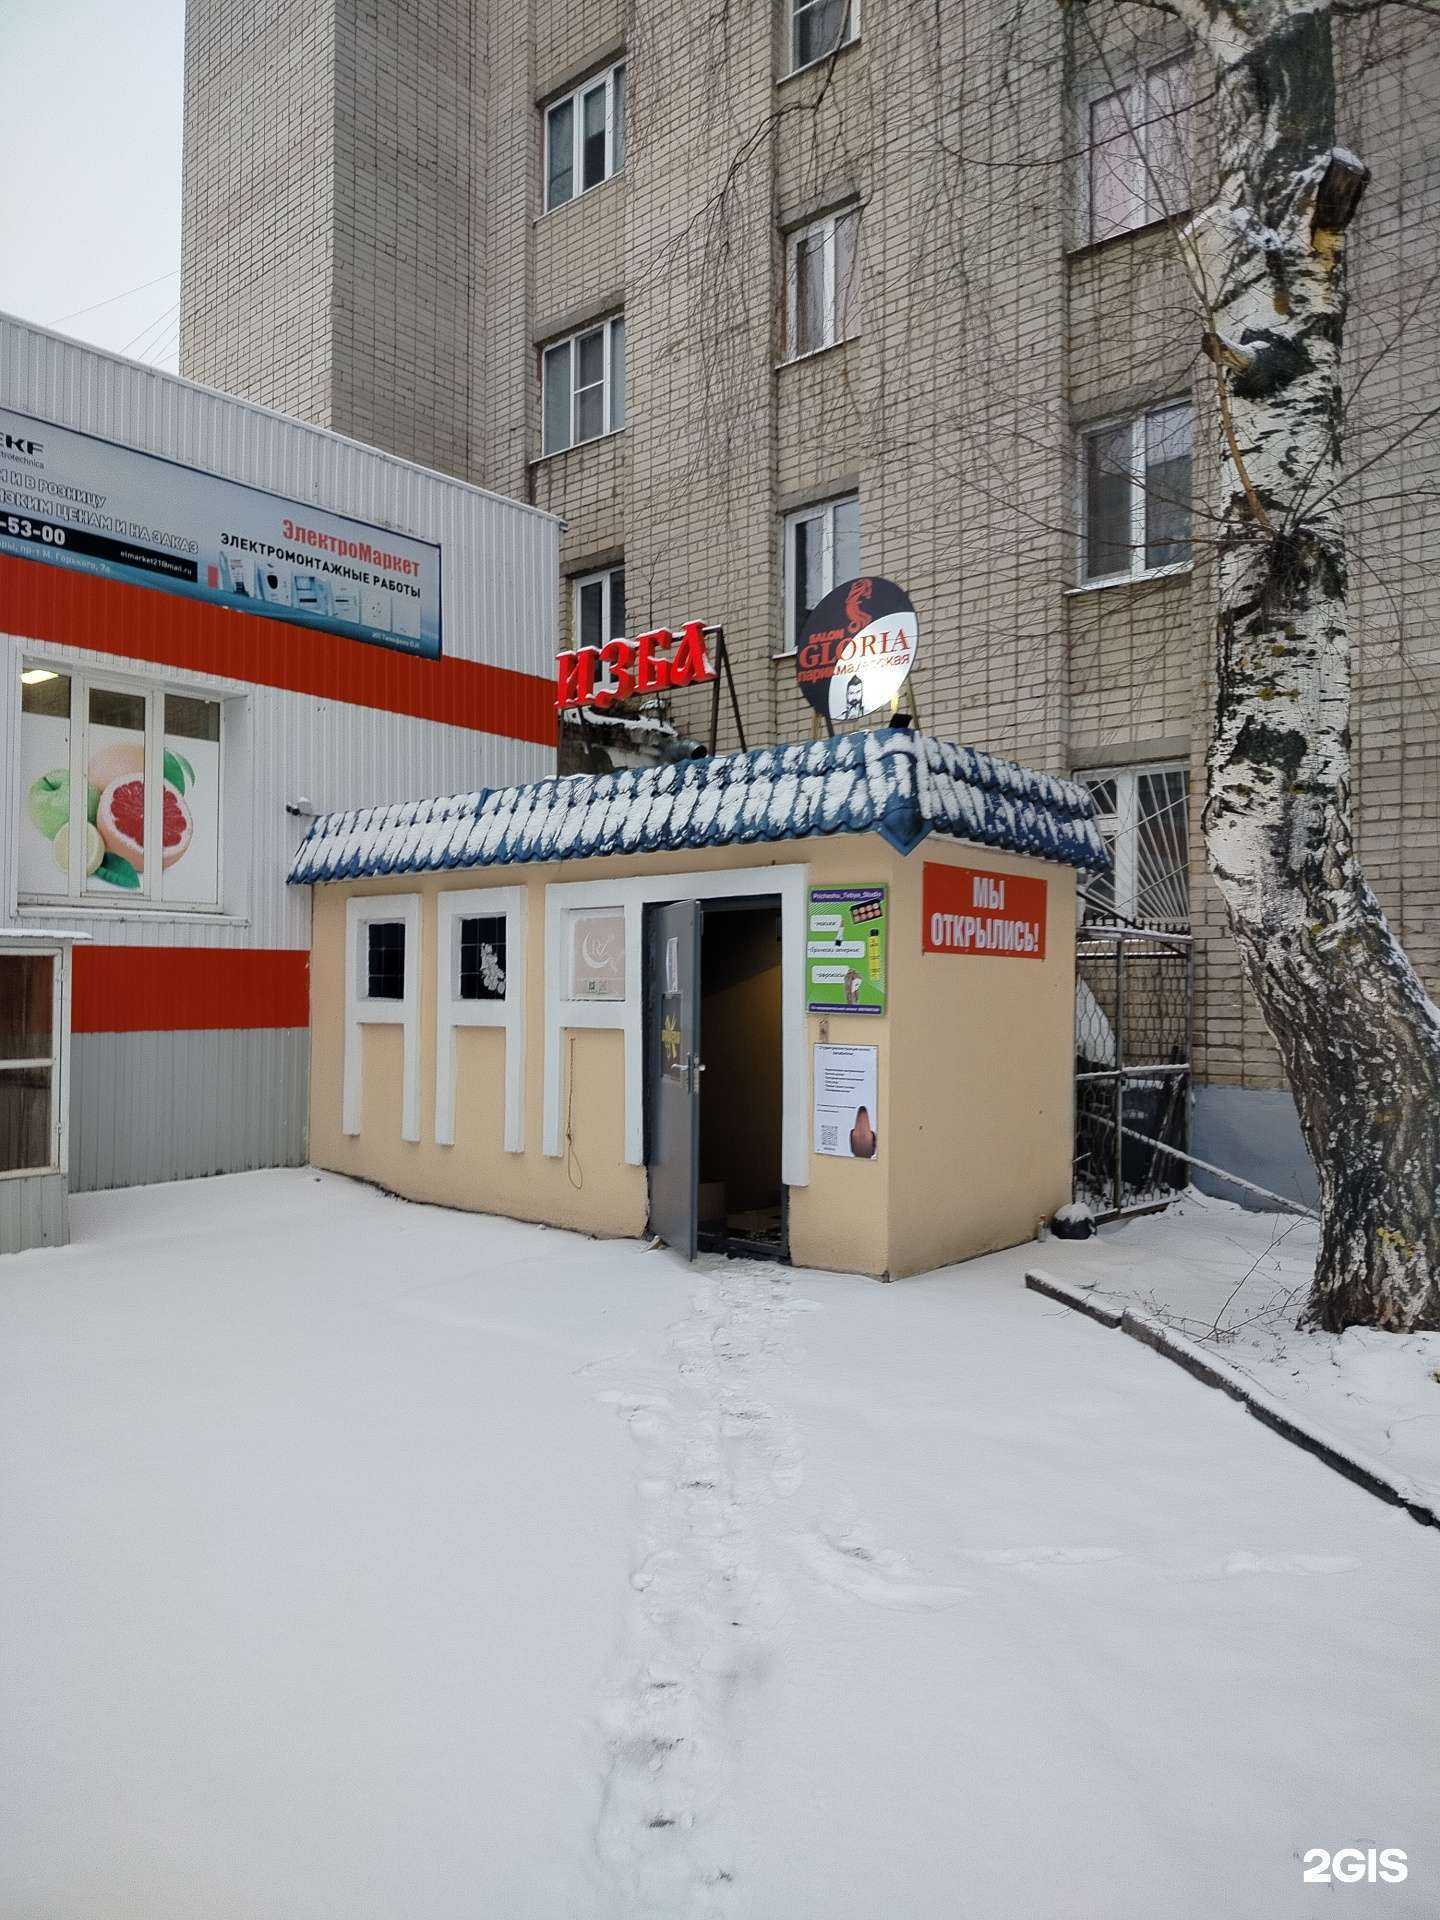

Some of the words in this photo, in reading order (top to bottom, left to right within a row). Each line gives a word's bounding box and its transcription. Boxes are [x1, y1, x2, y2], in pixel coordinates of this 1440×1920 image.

[10, 470, 22, 487] И
[24, 474, 36, 490] В
[38, 478, 107, 509] РОЗНИЦУ
[55, 503, 113, 532] ЦЕНАМ
[115, 519, 127, 534] И
[129, 521, 151, 542] НА
[152, 531, 199, 554] ЗАКАЗ
[282, 518, 421, 577] ЭлектроМаркет
[220, 532, 370, 584] ЭЛЕКТРОМОНТАЖНЫЕ
[373, 575, 421, 598] РАБОТЫ
[553, 619, 717, 707] ИЗБА
[799, 627, 912, 669] GLORIA
[972, 876, 1005, 910] МЫ
[930, 912, 1040, 952] ОТКРЫЛИСЬ!
